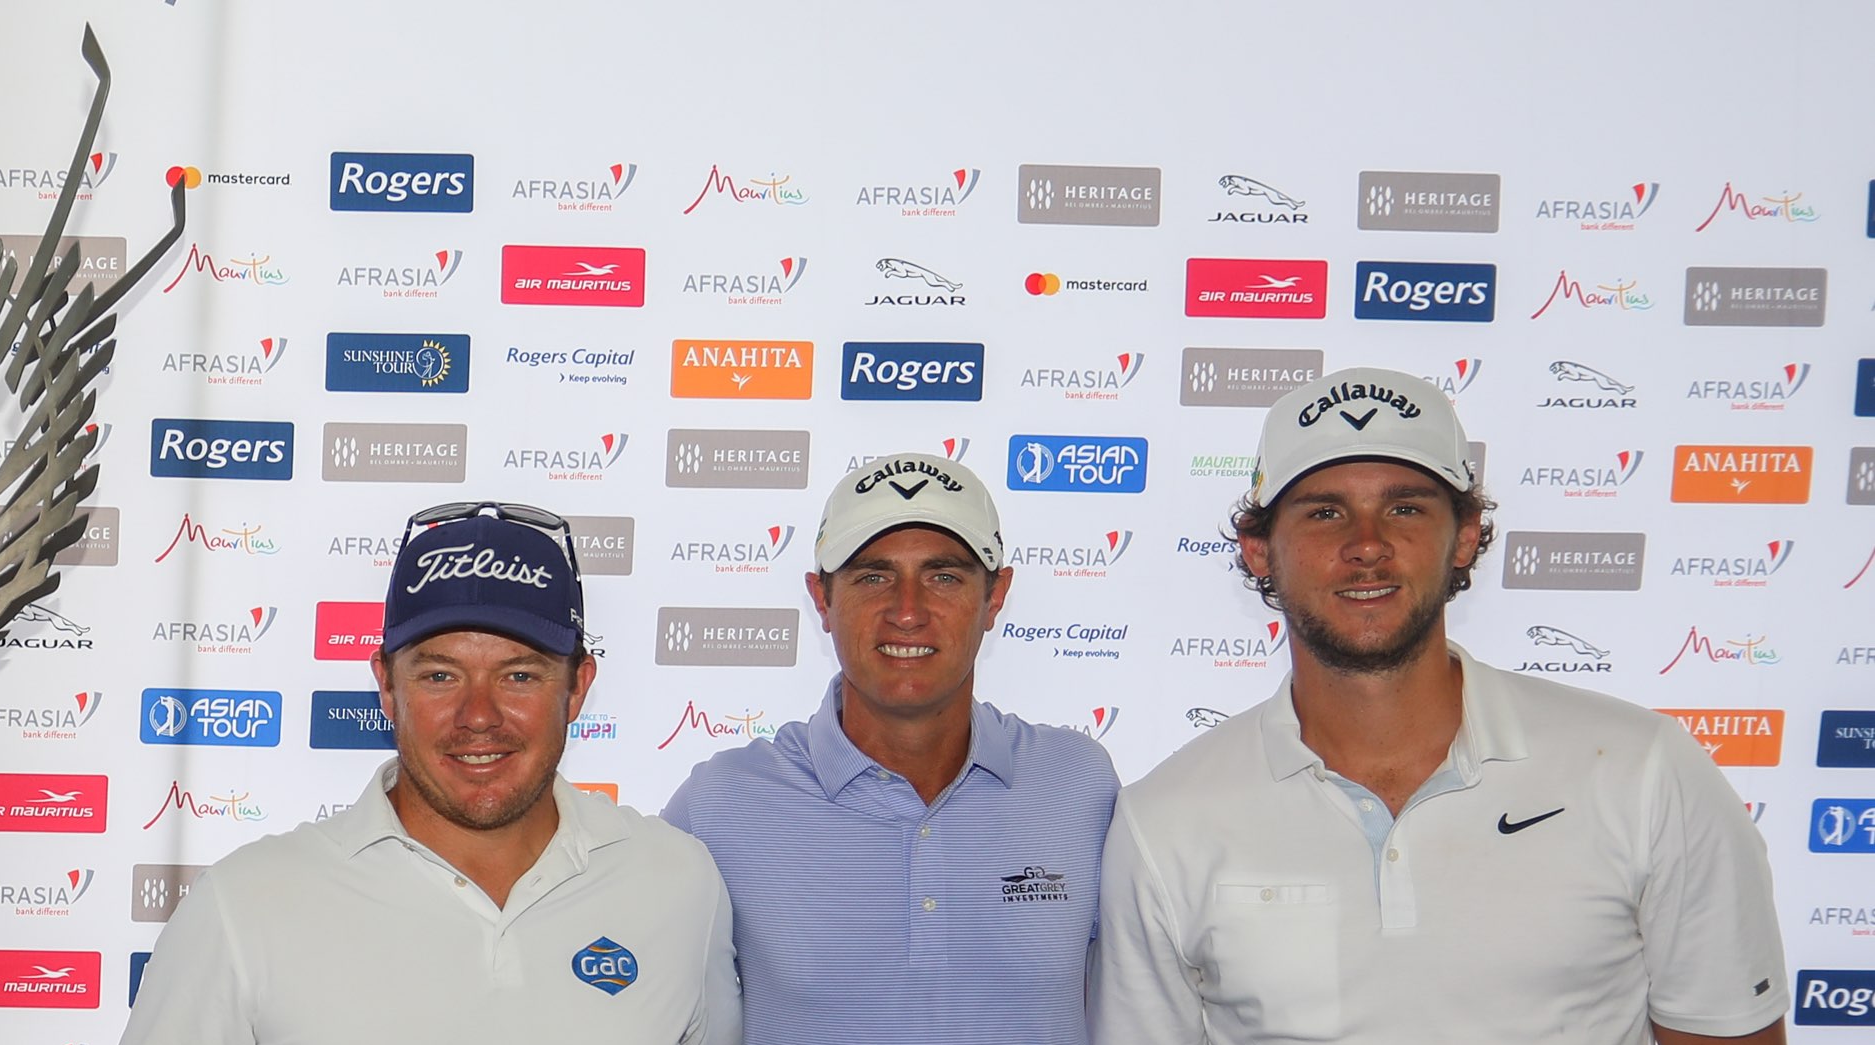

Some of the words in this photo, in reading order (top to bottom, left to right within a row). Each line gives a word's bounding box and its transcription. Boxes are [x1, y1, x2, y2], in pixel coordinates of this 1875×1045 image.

[208, 174, 289, 185] mastercard
[339, 163, 465, 201] Rogers
[684, 165, 802, 214] Mauritius
[579, 203, 611, 212] different
[1536, 201, 1634, 219] AFRASIA
[1208, 213, 1308, 223] JAGUAR
[1067, 280, 1147, 291] mastercard
[1364, 272, 1487, 310] Rogers
[1531, 270, 1649, 319] Mauritius
[163, 354, 261, 373] AFRASIA
[343, 349, 414, 362] SUNSHINE
[507, 348, 567, 366] Rogers
[572, 349, 634, 367] Capital
[681, 345, 802, 369] ANAHITA
[374, 361, 414, 374] TOUR
[850, 353, 975, 390] Rogers
[1228, 369, 1314, 382] HERITAGE
[569, 375, 590, 383] Keep
[592, 375, 627, 385] evolving
[1021, 369, 1118, 388] AFRASIA
[1298, 382, 1421, 427] Callaway
[1538, 398, 1636, 408] JAGUAR
[160, 429, 285, 468] Rogers
[1056, 444, 1140, 467] ASIAN
[1682, 451, 1802, 474] ANAHITA
[855, 460, 965, 494] Callaway
[1064, 463, 1133, 484] TOUR
[1520, 468, 1617, 486] AFRASIA
[155, 513, 273, 563] Mauritius
[1550, 552, 1635, 564] HERITAGE
[407, 543, 552, 593] Titleist
[153, 623, 251, 642] AFRASIA
[704, 628, 789, 640] HERITAGE
[1003, 623, 1062, 641] Rogers
[1067, 624, 1128, 642] Capital
[1063, 649, 1083, 657] Keep
[1085, 650, 1119, 659] evolving
[1659, 626, 1779, 674] Mauritius
[1514, 663, 1611, 672] JAGUAR
[189, 697, 273, 720] ASIAN
[581, 713, 596, 721] RACE
[198, 717, 267, 737] TOUR
[570, 722, 616, 740] DUBAI
[143, 781, 261, 829] Mauritius
[1003, 894, 1068, 902] INVESTMENTS
